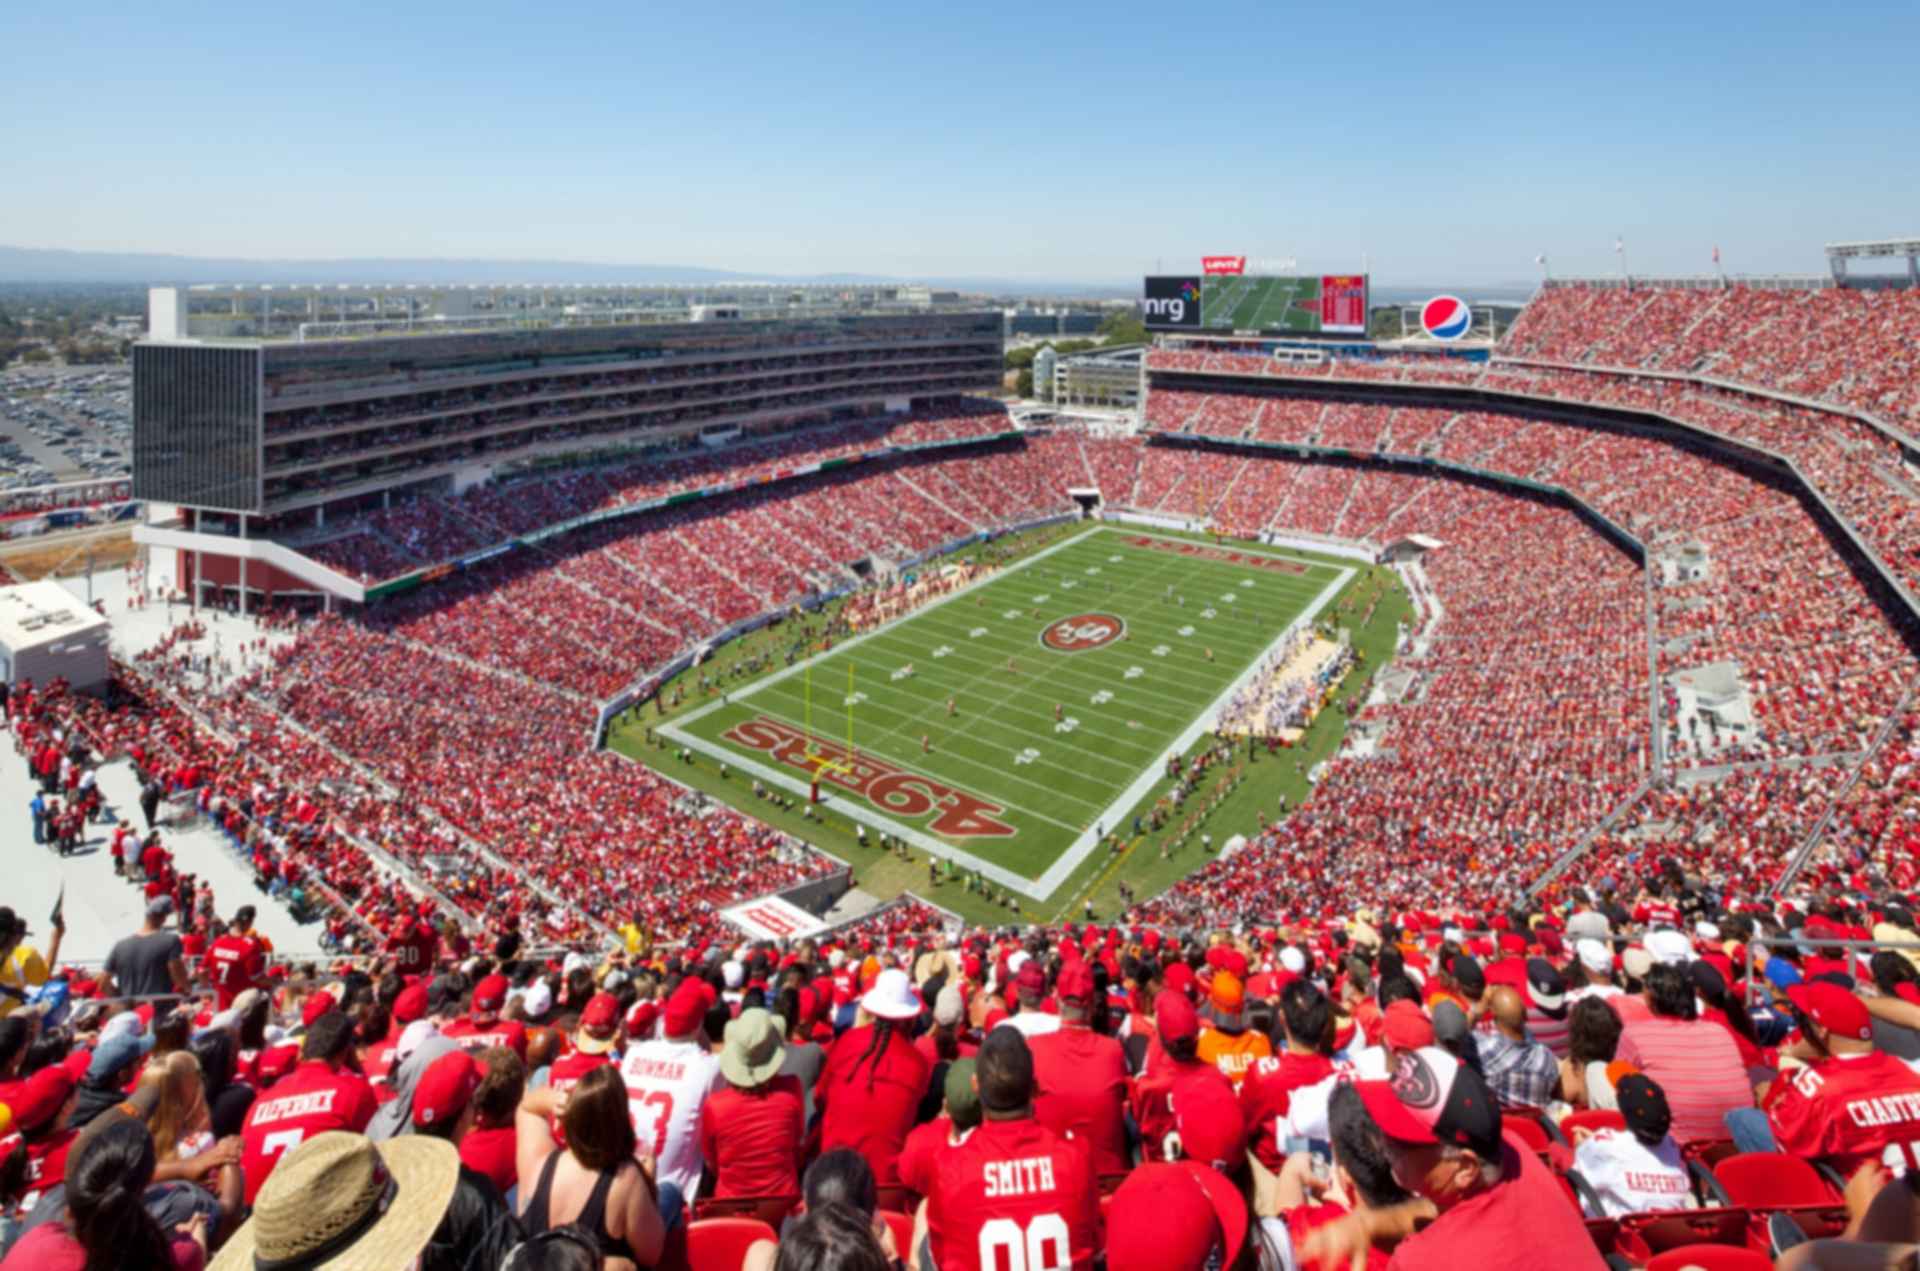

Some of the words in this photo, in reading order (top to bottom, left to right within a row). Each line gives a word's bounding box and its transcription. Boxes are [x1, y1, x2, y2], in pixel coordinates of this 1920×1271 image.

[1145, 297, 1184, 322] nrg
[718, 714, 1018, 839] 49ERS
[215, 961, 230, 984] 7
[983, 1155, 1055, 1198] SMITH
